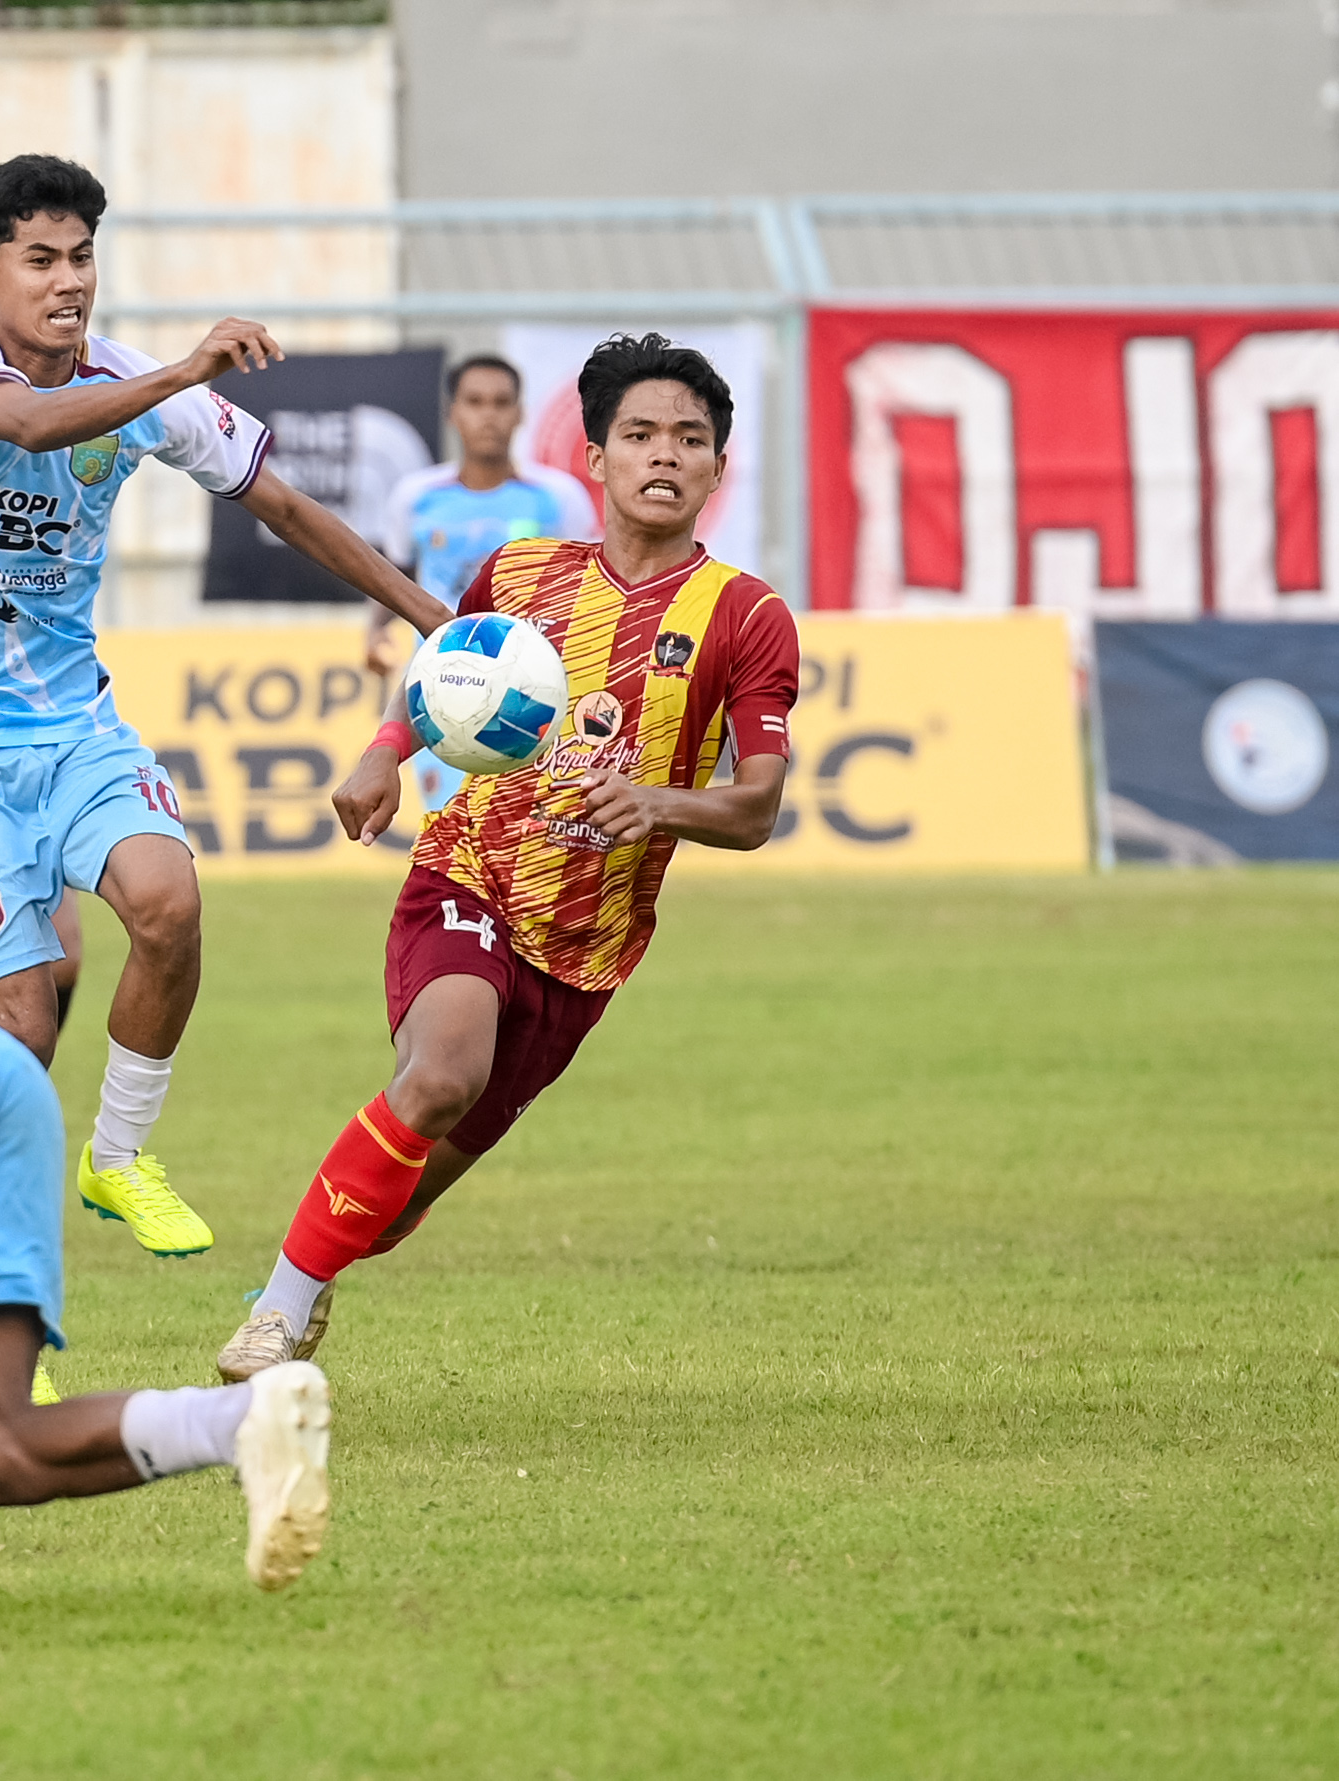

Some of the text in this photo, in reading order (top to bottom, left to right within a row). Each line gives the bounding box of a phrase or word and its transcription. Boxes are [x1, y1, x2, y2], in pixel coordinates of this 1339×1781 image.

[440, 673, 486, 687] molten
[533, 735, 644, 781] Kapal Api
[131, 779, 182, 824] 10
[548, 820, 615, 847] mangg
[440, 898, 498, 952] 4
